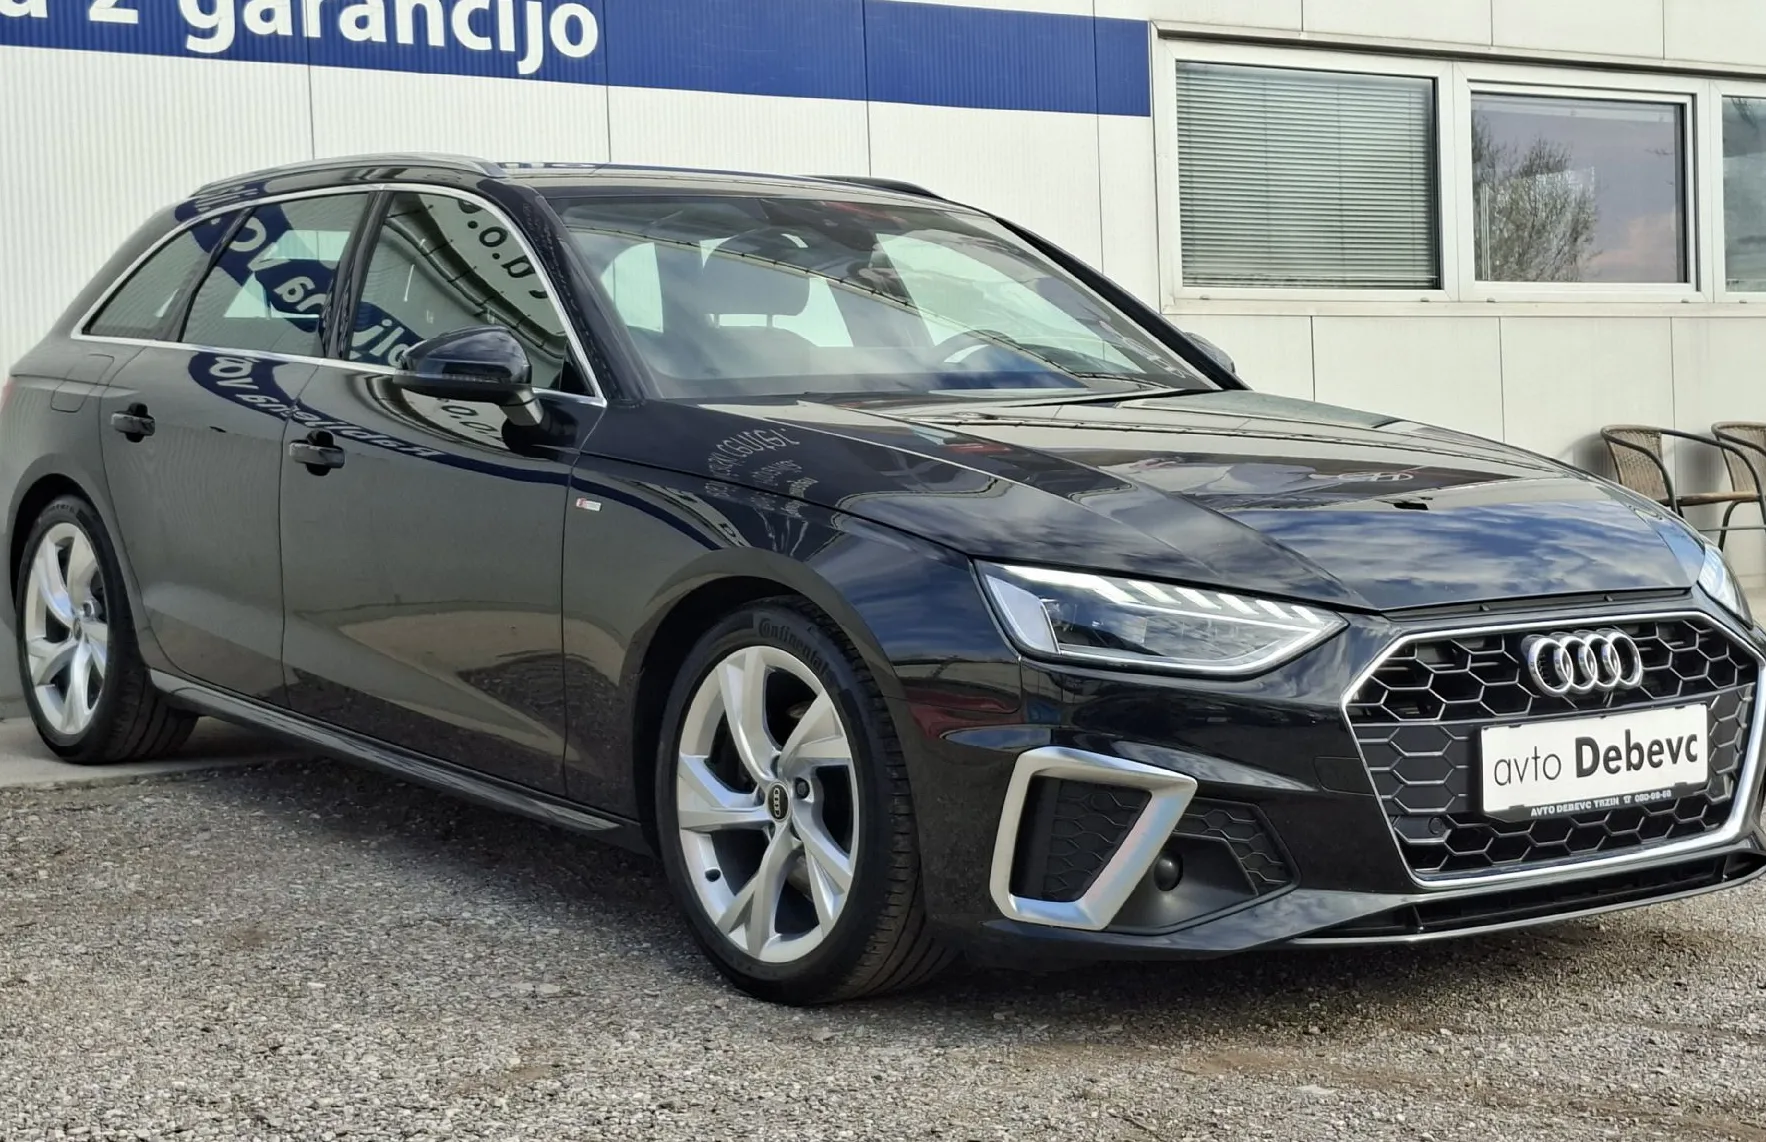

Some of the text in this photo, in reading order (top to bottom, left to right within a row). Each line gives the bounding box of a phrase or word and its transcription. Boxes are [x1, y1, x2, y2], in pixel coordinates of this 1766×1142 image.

[179, 0, 598, 74] garancijo
[759, 618, 829, 676] Continental
[1494, 729, 1698, 786] avto Debevc
[1530, 805, 1555, 817] AVTO
[1556, 801, 1592, 814] DEBEVC
